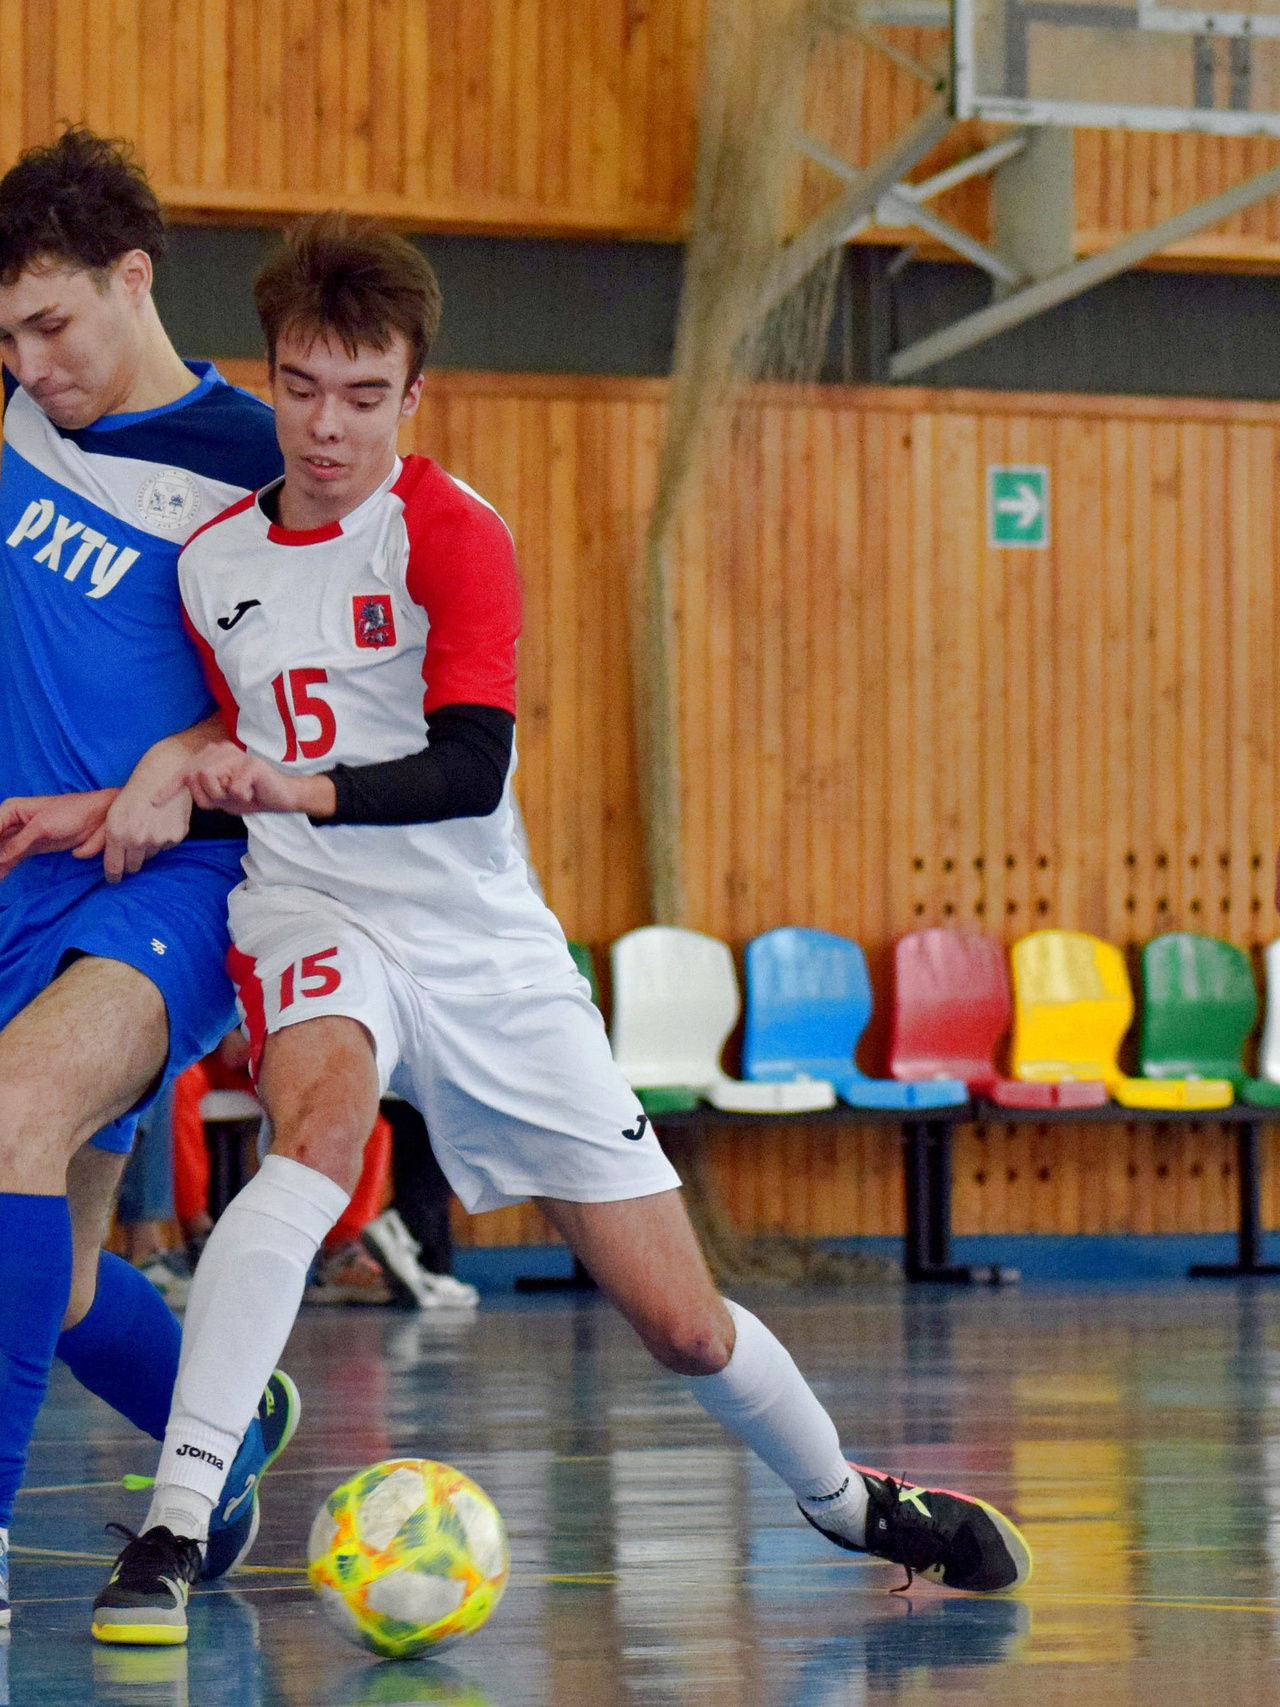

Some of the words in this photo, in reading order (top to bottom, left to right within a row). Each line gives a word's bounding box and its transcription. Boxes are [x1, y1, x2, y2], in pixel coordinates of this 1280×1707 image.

[6, 498, 141, 599] РХТУ
[271, 667, 337, 762] 15
[279, 946, 342, 1013] 15
